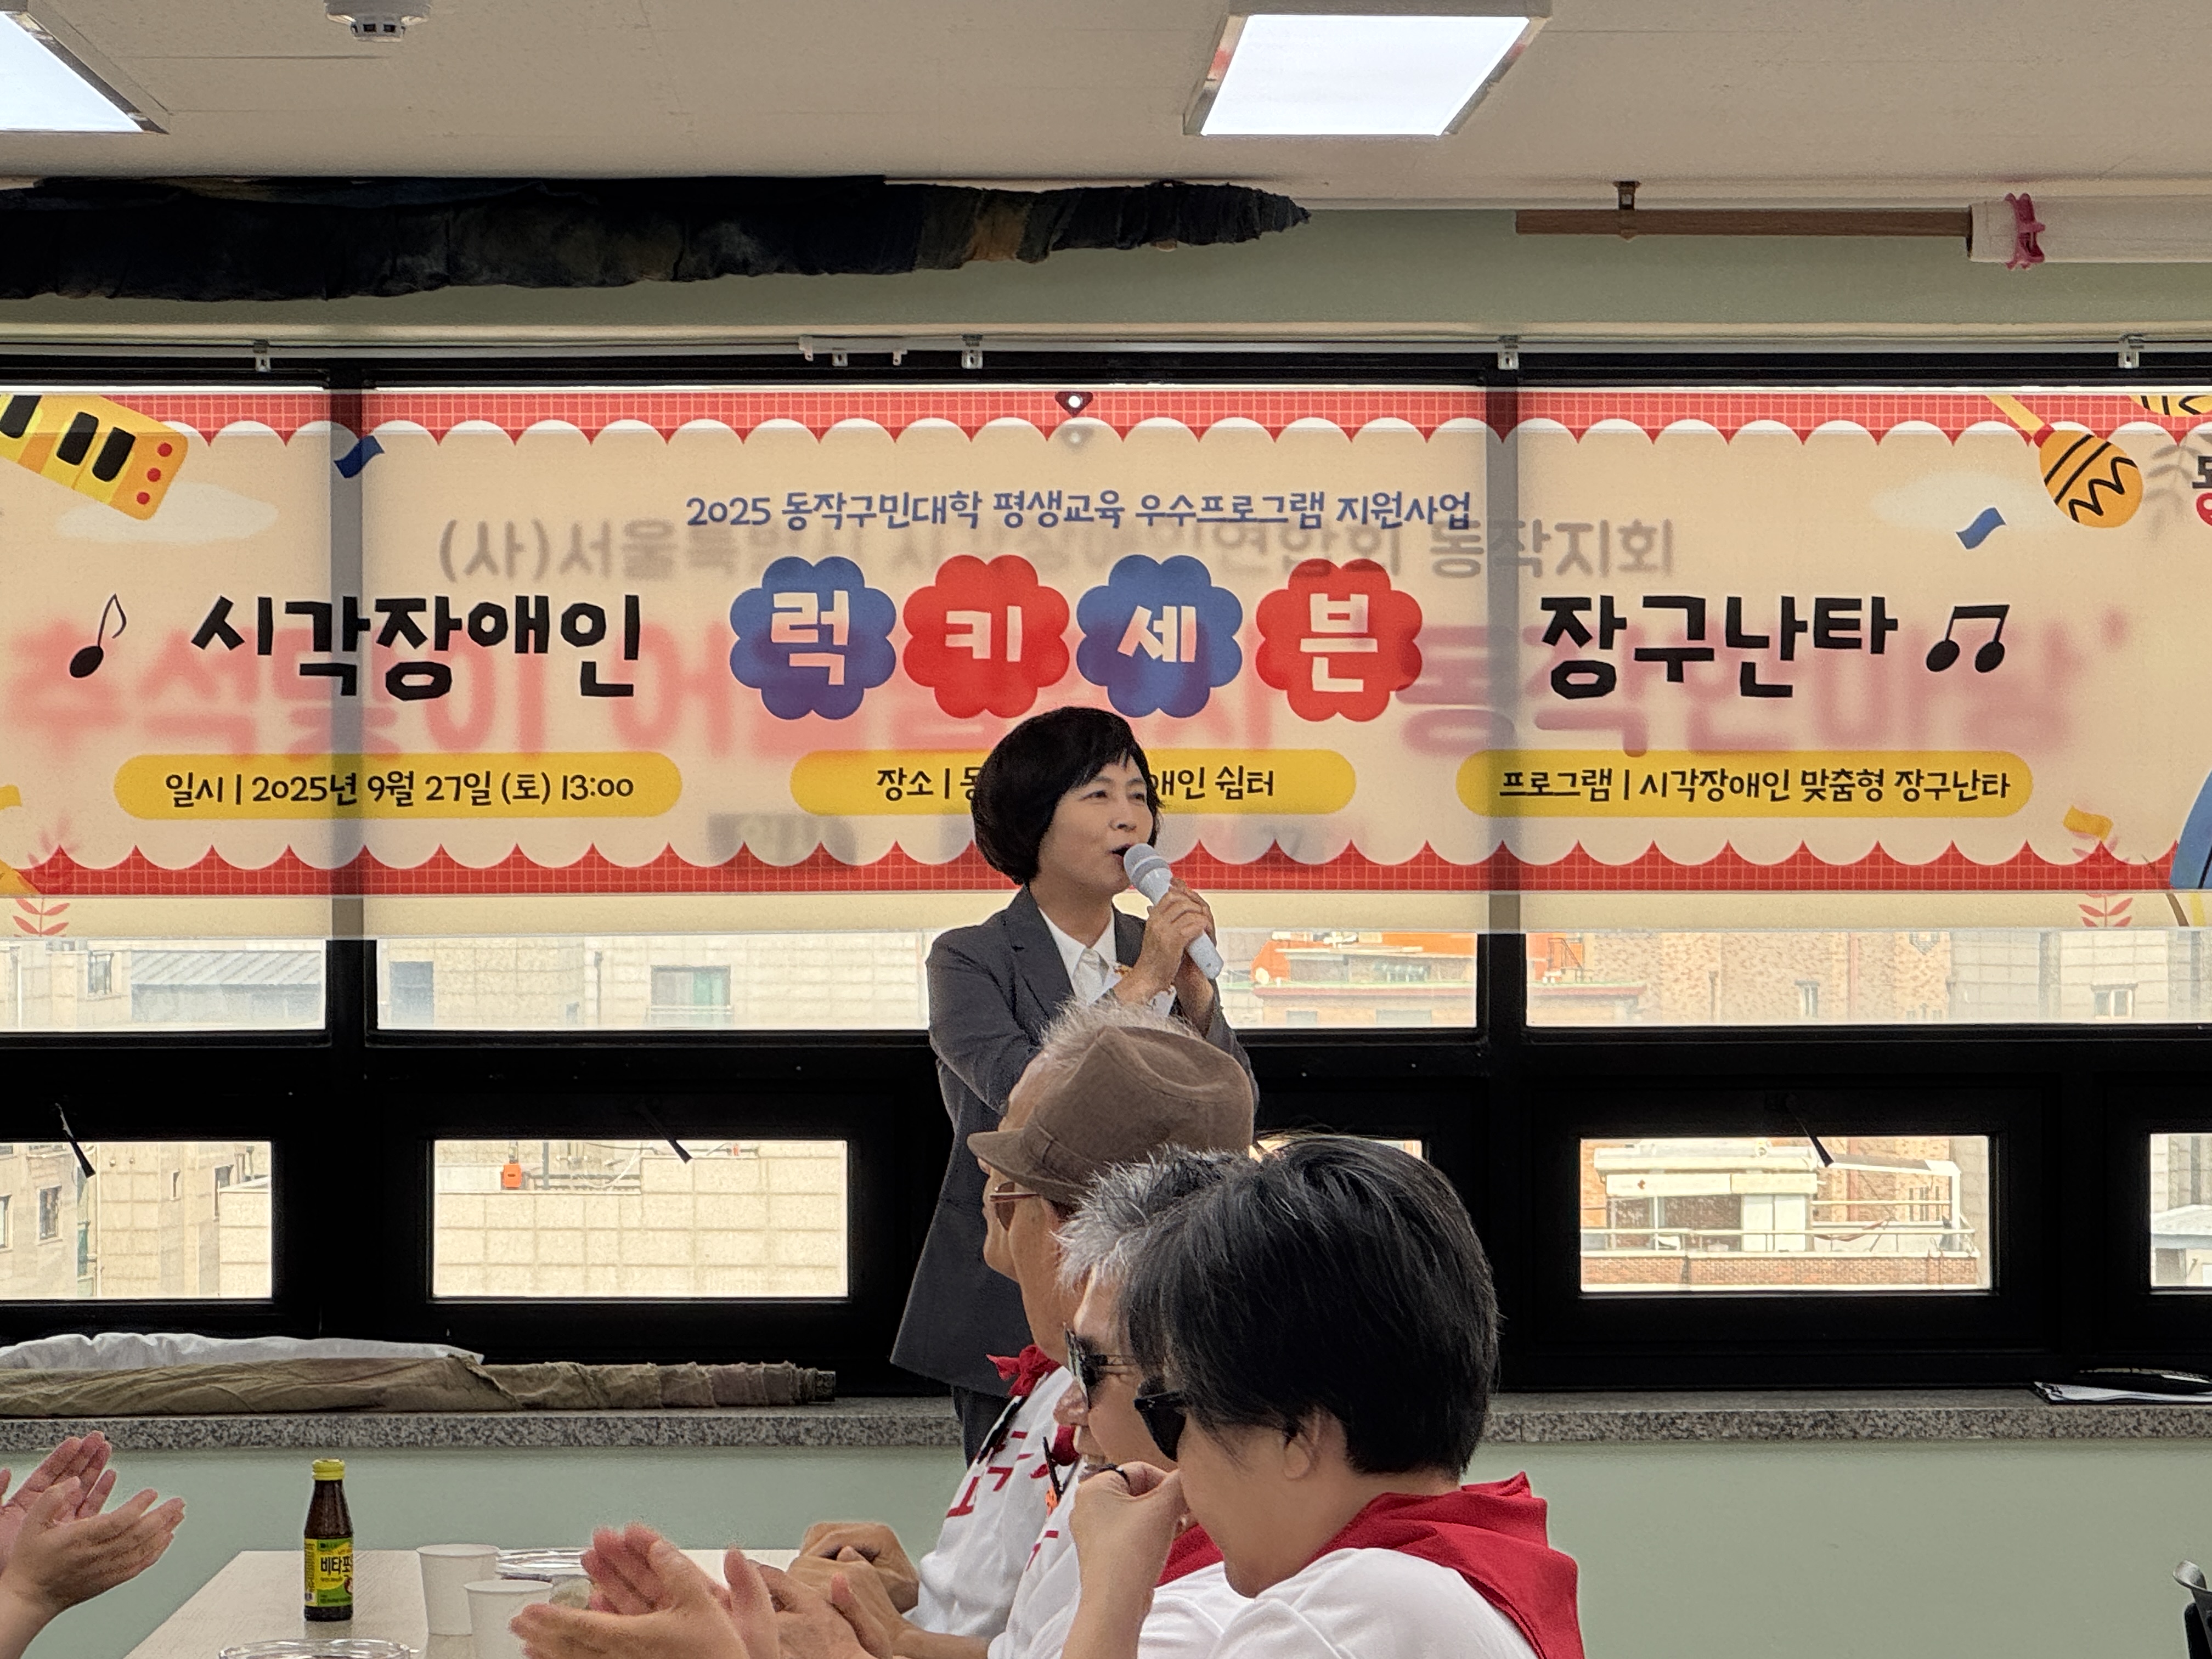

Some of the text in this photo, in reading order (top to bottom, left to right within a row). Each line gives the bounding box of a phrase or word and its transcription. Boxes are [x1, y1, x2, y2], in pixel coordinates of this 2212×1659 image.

[687, 491, 1470, 529] 2025 동작구민대학 평생교육 우수프로그램 지원사업
[191, 595, 641, 701] 시각장애인
[1540, 595, 1899, 699] 장구난타
[165, 772, 223, 808] 일시
[252, 772, 358, 806] 2025년
[367, 771, 414, 807] 9월
[425, 771, 492, 806] 27일
[501, 771, 551, 804] (토)
[562, 774, 634, 801] 13:00
[877, 767, 934, 802] 장소
[1215, 765, 1274, 800] 쉼터
[1499, 768, 1613, 802] 프로그램
[1639, 768, 1790, 802] 시각장애인
[1801, 768, 1885, 803] 맞춤형
[1894, 768, 2011, 803] 장구난타
